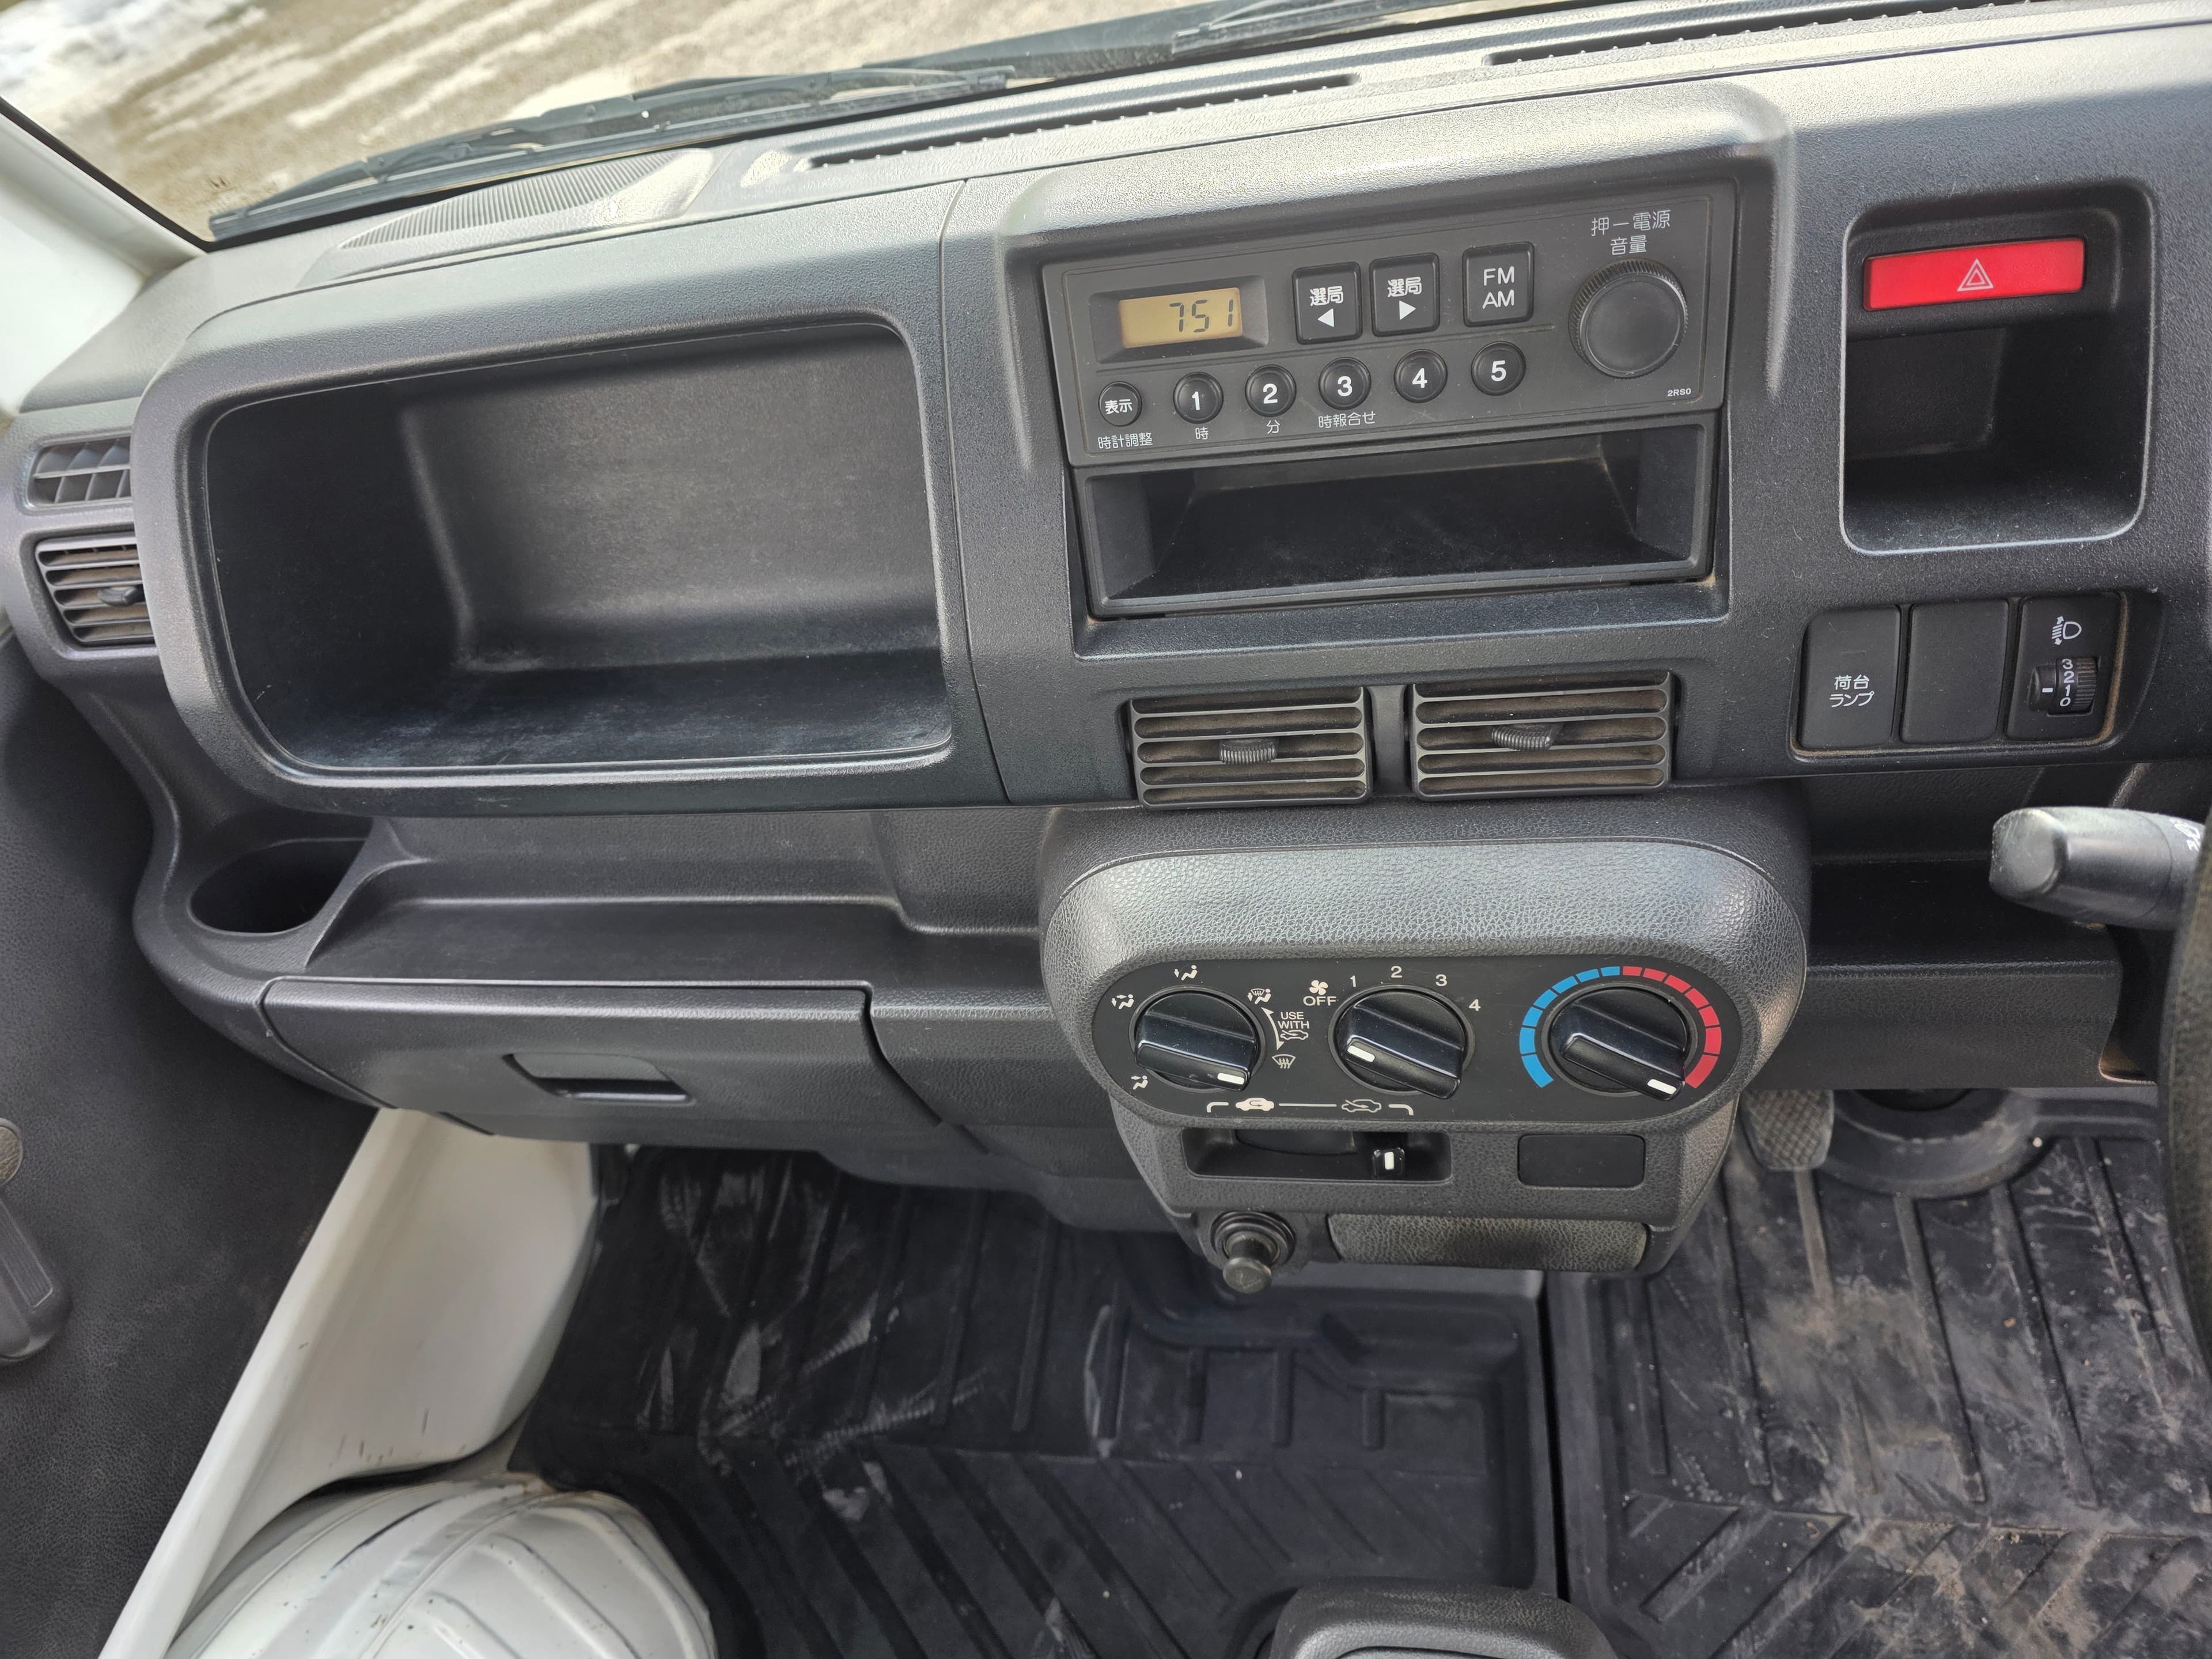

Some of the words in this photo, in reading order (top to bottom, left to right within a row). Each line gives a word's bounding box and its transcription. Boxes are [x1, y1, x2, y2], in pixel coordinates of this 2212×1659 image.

[1610, 234, 1647, 255] 音量
[1483, 266, 1514, 286] FM
[1387, 276, 1422, 298] 選局
[1309, 285, 1344, 306] 選局
[1482, 289, 1514, 309] AM
[1169, 298, 1234, 333] 751
[1412, 368, 1428, 388] 4
[1491, 360, 1506, 382] 5
[1263, 383, 1278, 404] 2
[1338, 376, 1353, 397] 3
[1105, 399, 1132, 415] 表示
[1192, 391, 1201, 411] 1
[1266, 419, 1281, 434] 分
[1318, 410, 1376, 429] 時報合せ
[1097, 432, 1153, 449] 時計調整
[1195, 426, 1209, 440] 時
[2062, 658, 2074, 669] 3
[1834, 674, 1870, 690] 荷台
[2063, 671, 2074, 683] 2
[2065, 684, 2071, 697] 1
[1829, 691, 1874, 707] ランプ
[2059, 697, 2071, 707] 0
[1391, 965, 1403, 978] 2
[1350, 975, 1357, 987] 1
[1435, 974, 1448, 987] 3
[1303, 995, 1337, 1006] OFF
[1468, 999, 1481, 1012] 4
[1280, 1012, 1305, 1020] USE
[1277, 1020, 1310, 1029] WITH
